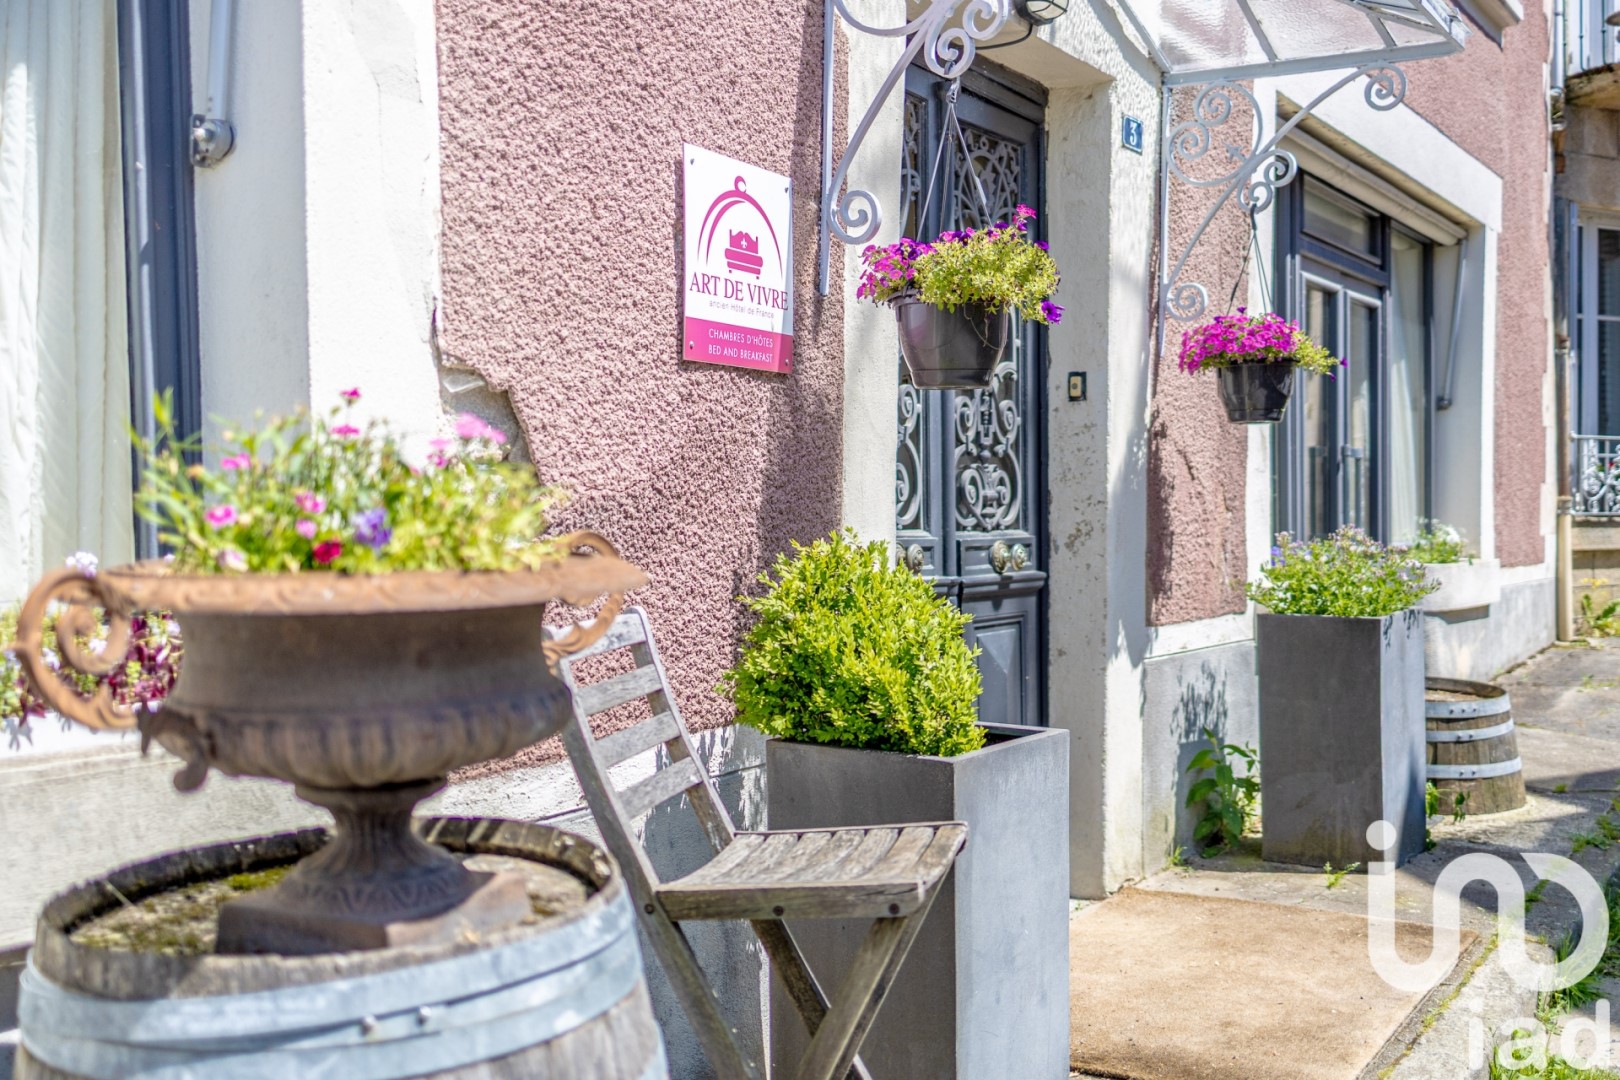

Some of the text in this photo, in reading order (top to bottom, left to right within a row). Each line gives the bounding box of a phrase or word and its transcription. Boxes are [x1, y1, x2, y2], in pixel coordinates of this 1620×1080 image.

[1129, 120, 1138, 146] 3
[689, 271, 789, 311] ART DE VIVRE
[708, 328, 774, 348] CHAMBRES D'HÔTES
[708, 343, 773, 363] BED AND BREAKFAST
